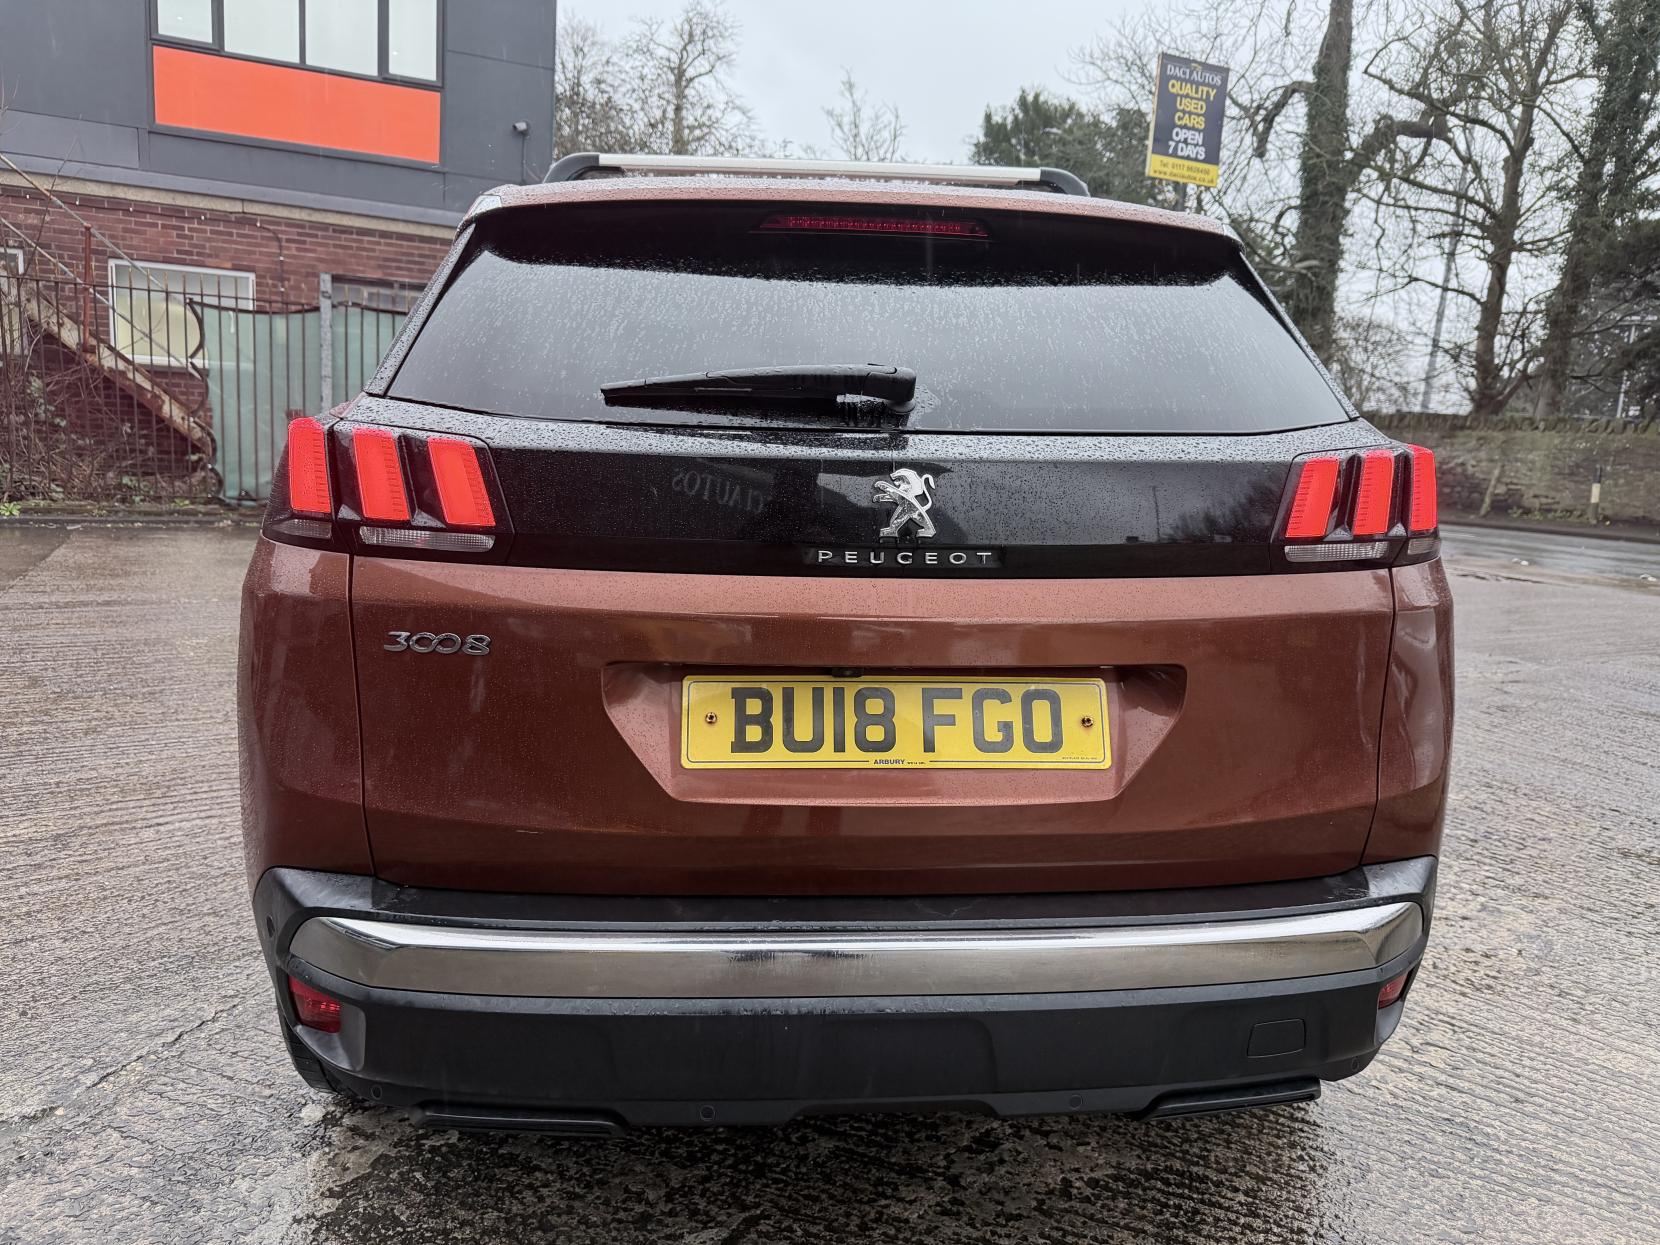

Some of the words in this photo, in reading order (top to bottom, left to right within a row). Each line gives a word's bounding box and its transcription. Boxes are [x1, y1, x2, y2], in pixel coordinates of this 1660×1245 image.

[1167, 64, 1190, 80] DACI
[1190, 70, 1222, 86] AUTOS
[1168, 79, 1217, 101] QUALITY
[1176, 97, 1206, 114] USED
[1174, 112, 1205, 130] CARS
[1172, 127, 1203, 146] OPEN
[1168, 141, 1175, 154] 7
[1177, 144, 1206, 160] DAYS
[817, 550, 992, 565] PEUGEOT
[383, 631, 491, 656] 3008
[730, 686, 896, 753] BU18
[921, 687, 1063, 754] FGO
